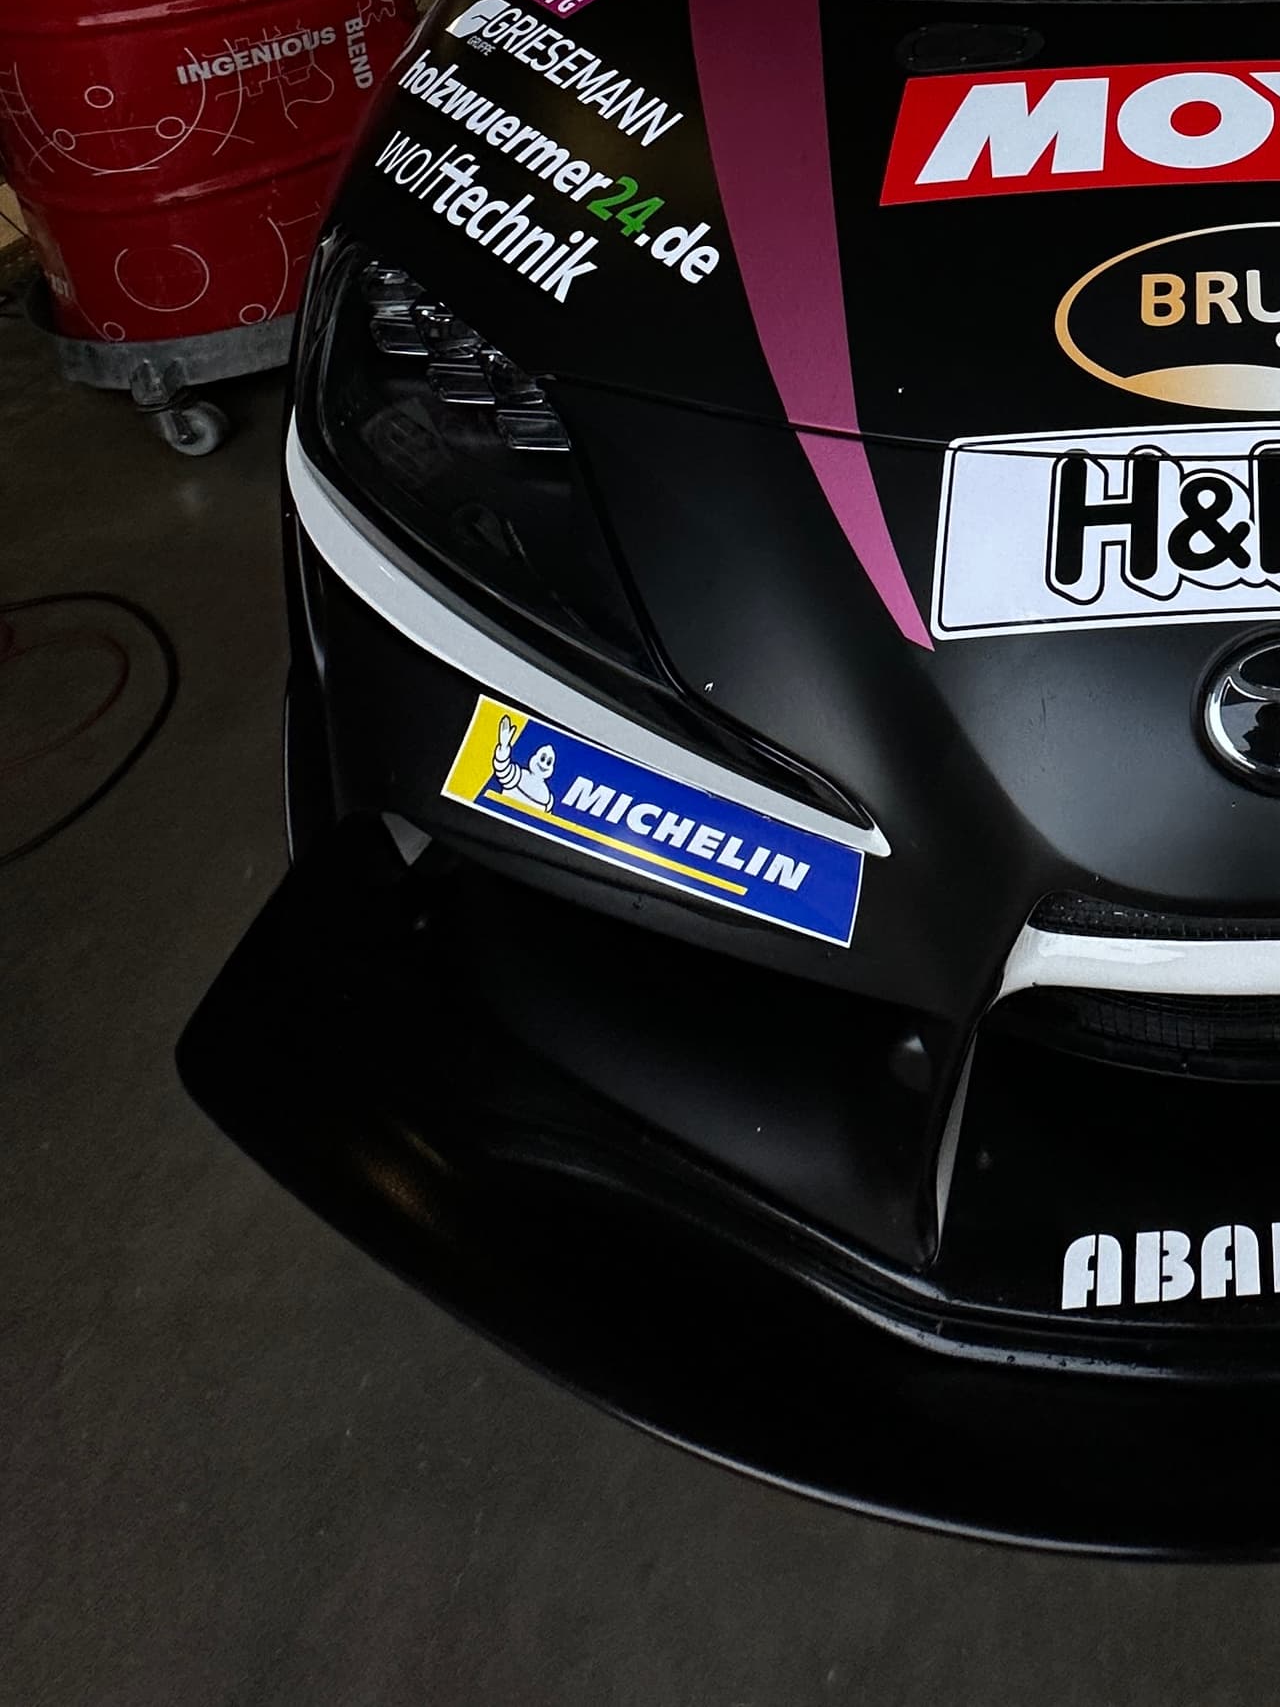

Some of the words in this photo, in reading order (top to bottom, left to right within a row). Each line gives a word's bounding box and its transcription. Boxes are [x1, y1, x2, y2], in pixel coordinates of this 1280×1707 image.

[177, 26, 337, 85] INGENIOUS
[344, 16, 374, 90] BLEND
[482, 6, 684, 147] GRIESEMANN
[398, 48, 720, 284] holzwuermer24.de
[561, 775, 811, 893] MICHELIN
